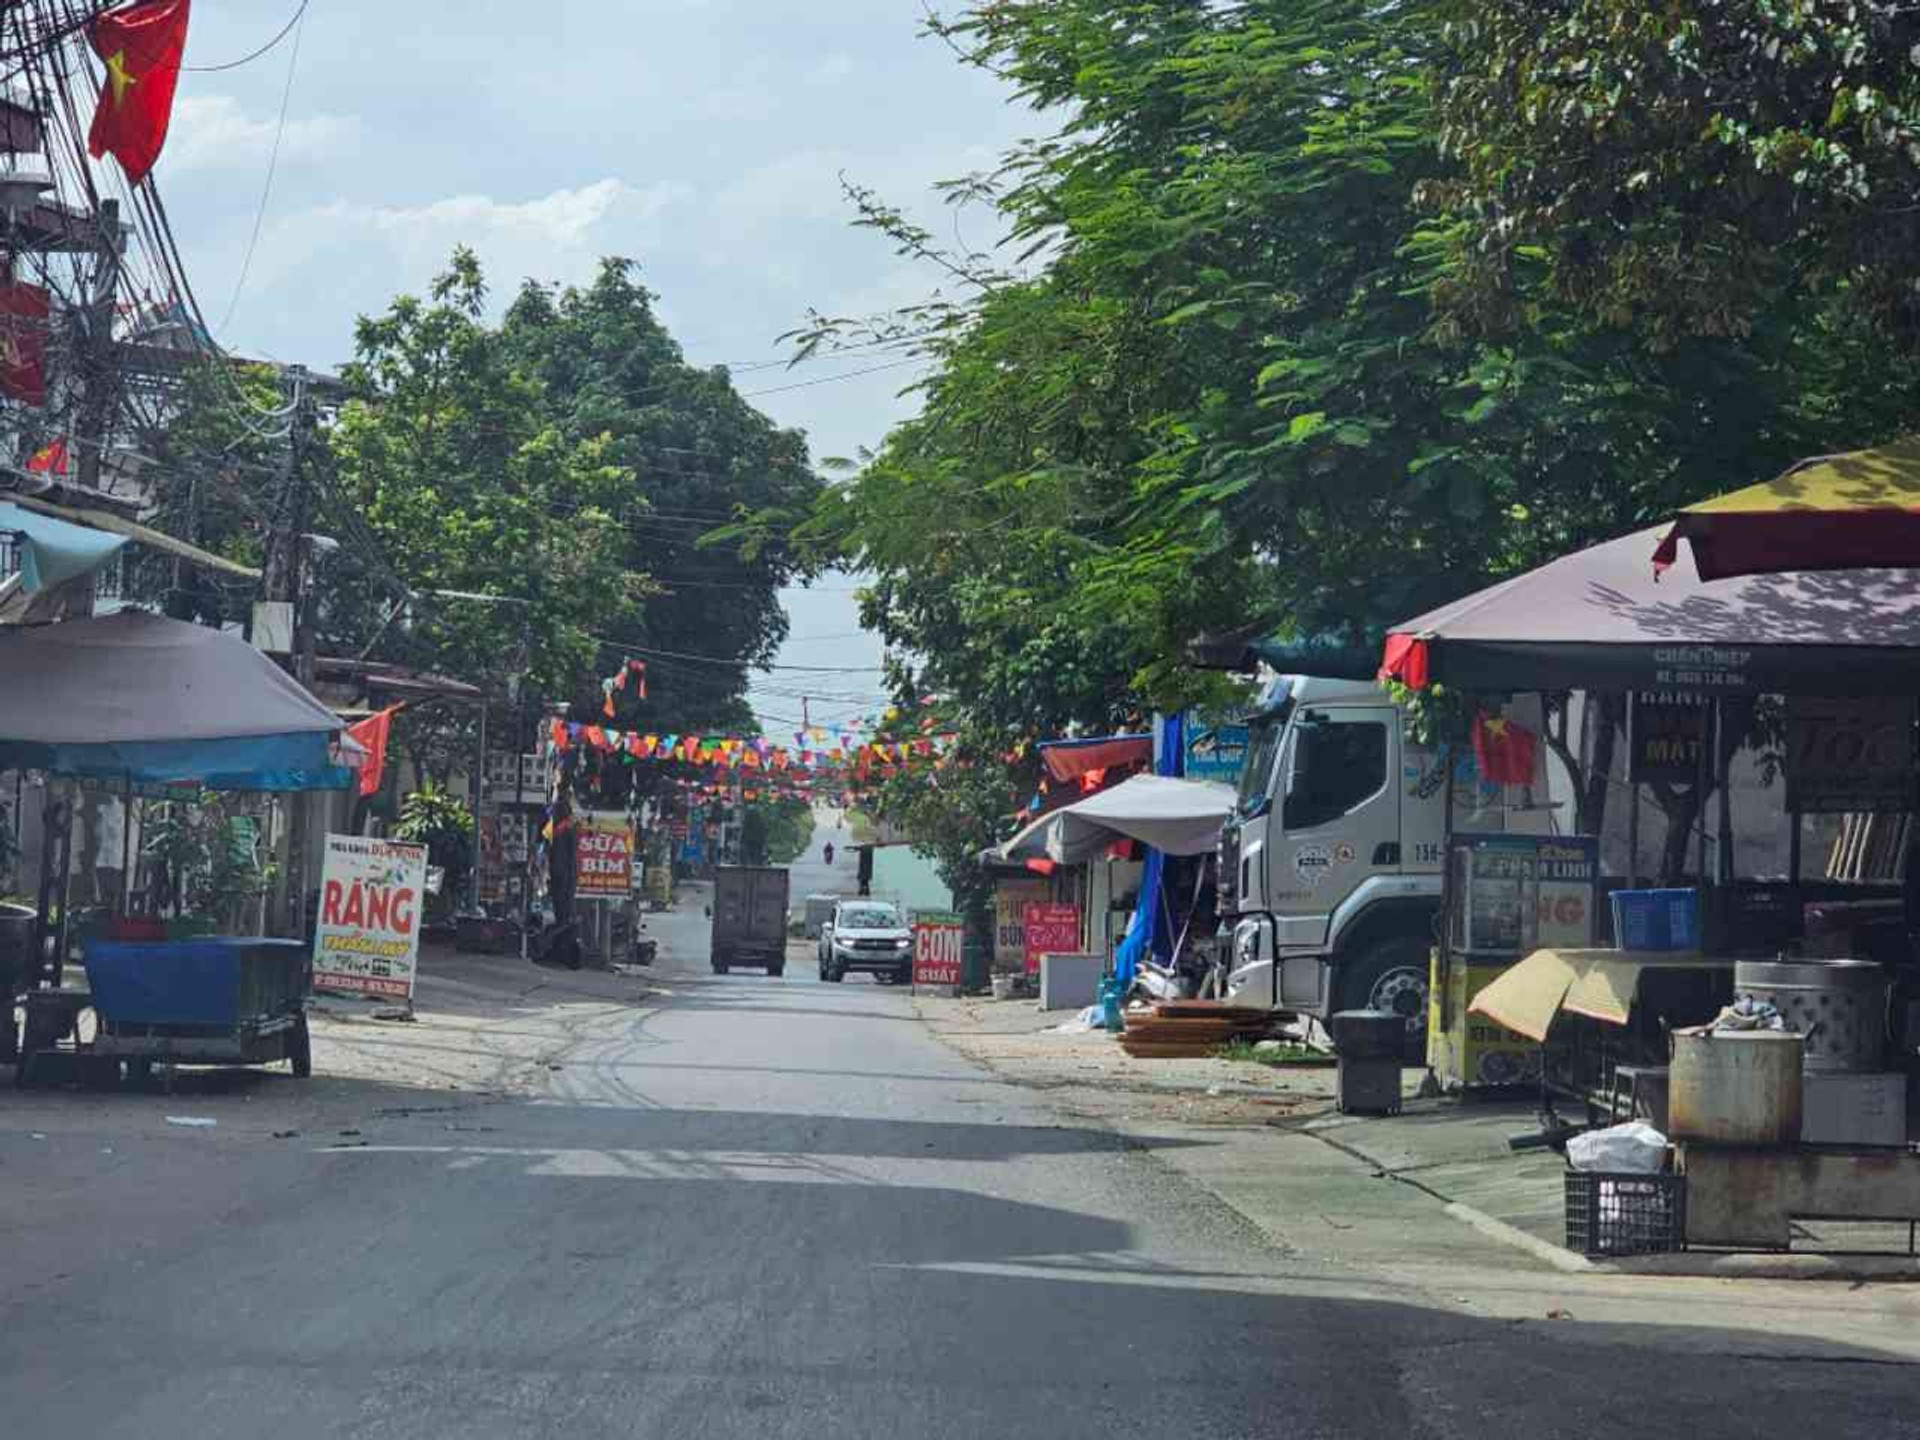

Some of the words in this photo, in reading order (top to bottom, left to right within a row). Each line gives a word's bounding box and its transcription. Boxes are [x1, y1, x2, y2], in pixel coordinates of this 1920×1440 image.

[577, 833, 625, 852] SỮA
[322, 877, 415, 935] RĂNG
[916, 925, 961, 962] CƠM
